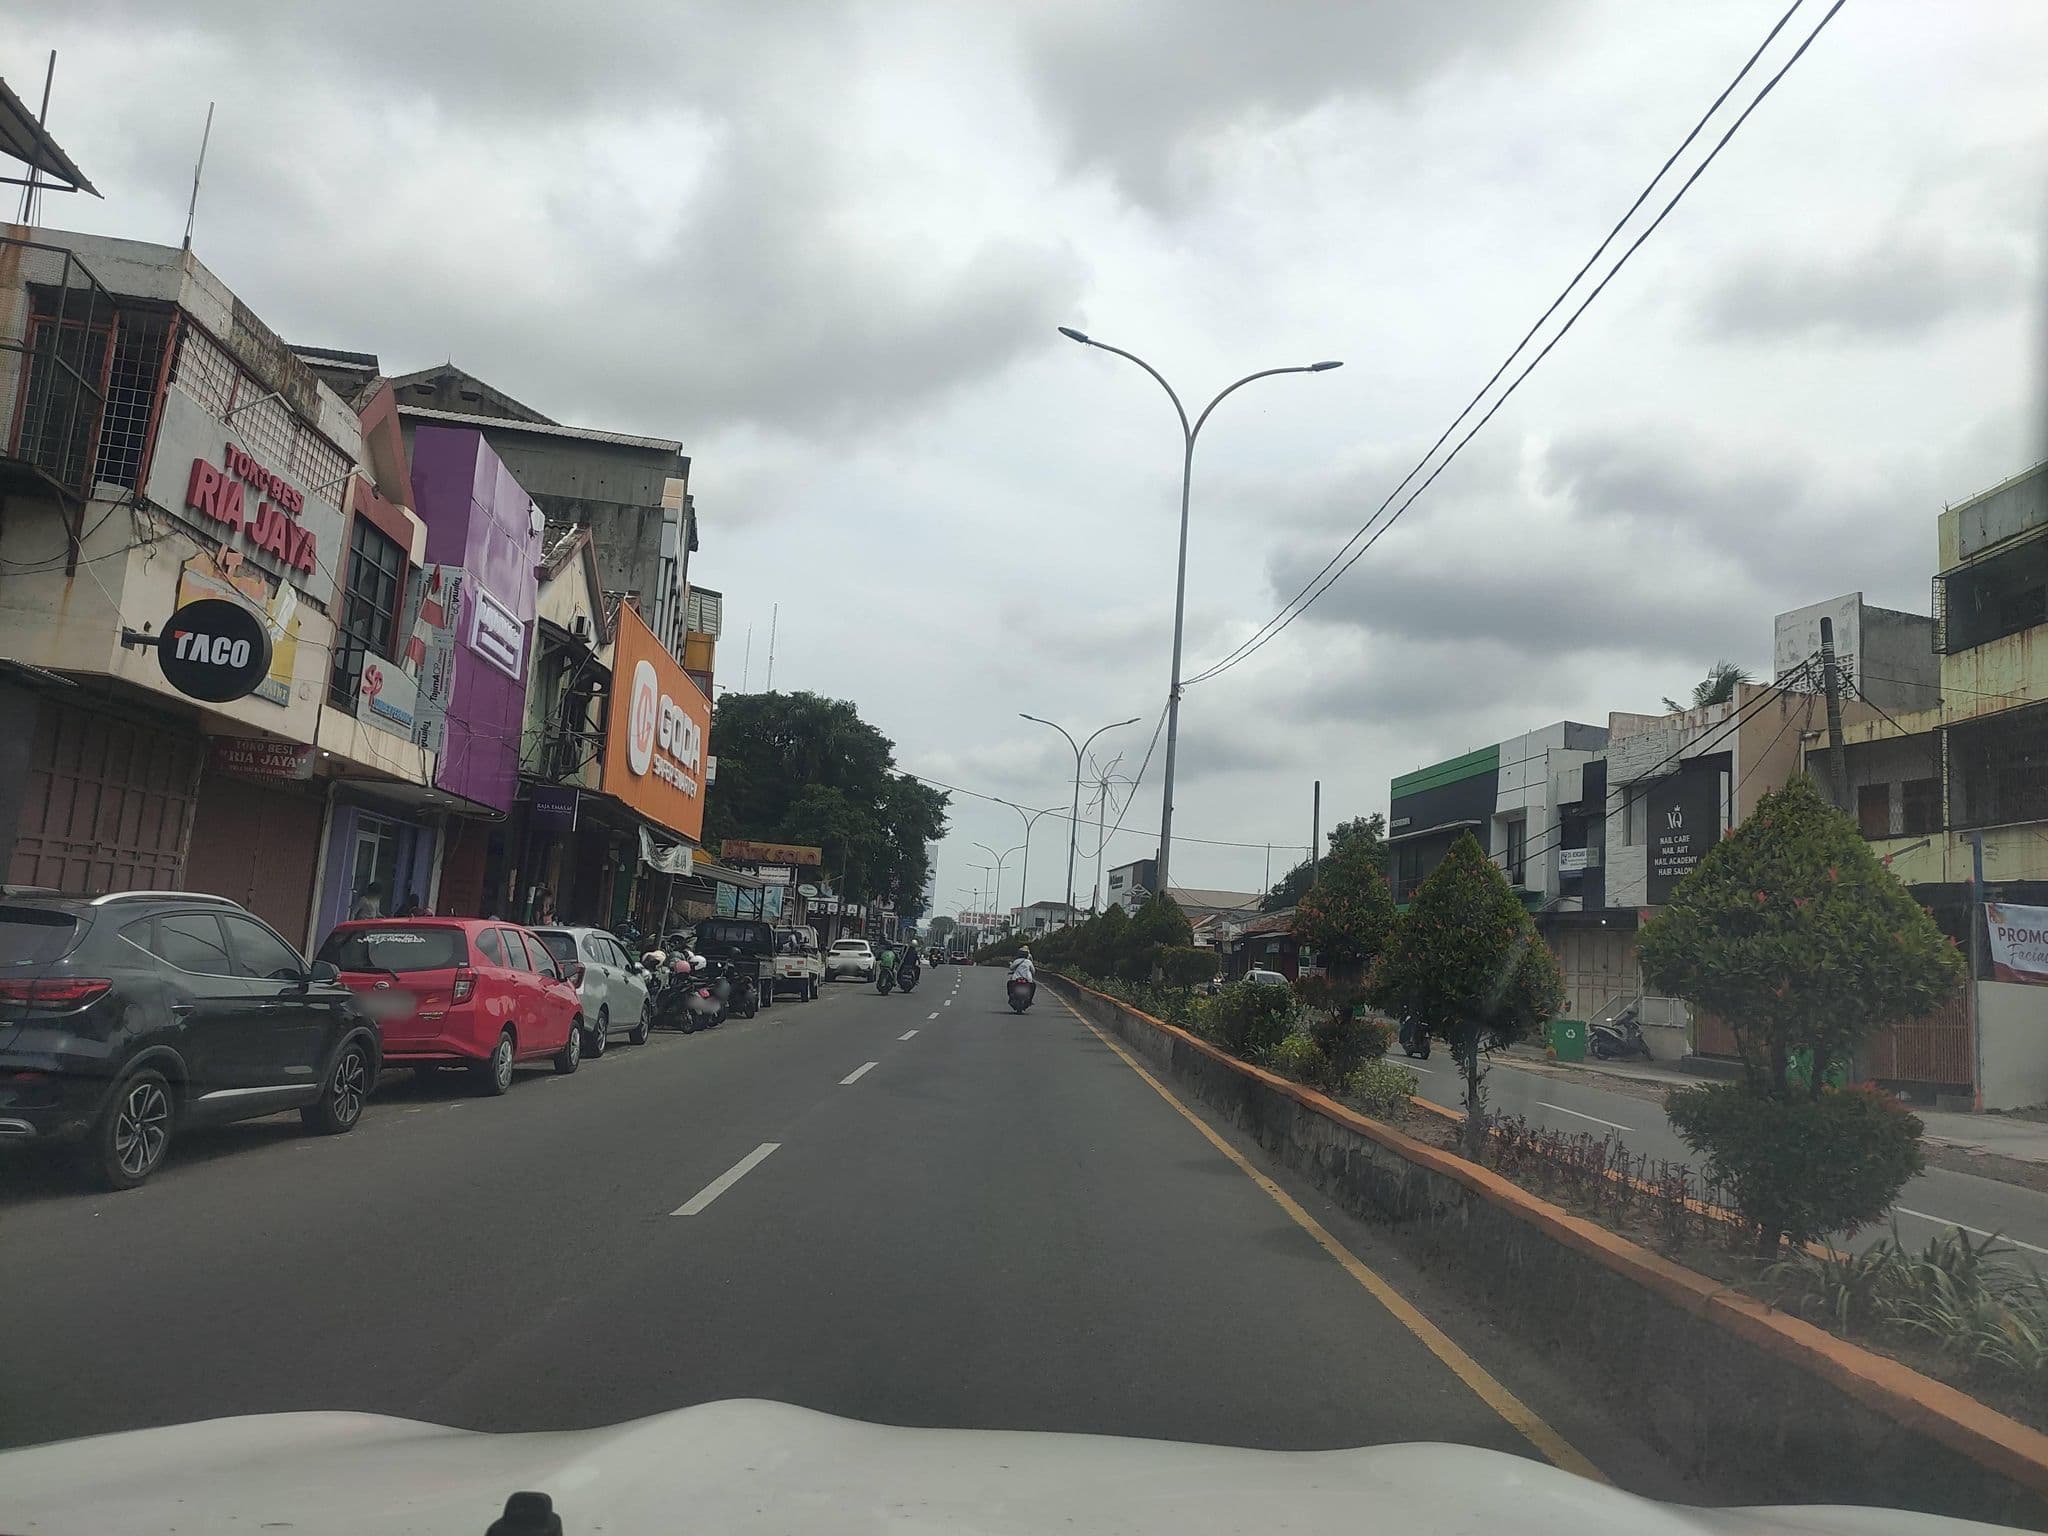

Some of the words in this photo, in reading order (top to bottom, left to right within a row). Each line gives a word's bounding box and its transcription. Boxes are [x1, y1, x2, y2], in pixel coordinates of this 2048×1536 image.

[225, 442, 270, 491] TOKO
[267, 475, 305, 516] BESI
[186, 458, 244, 532] RIA
[245, 502, 317, 575] JAYA
[174, 630, 250, 668] TACO
[1654, 857, 1667, 866] NAIL
[1669, 855, 1697, 865] ACADEMY
[1658, 867, 1672, 876] HAIR
